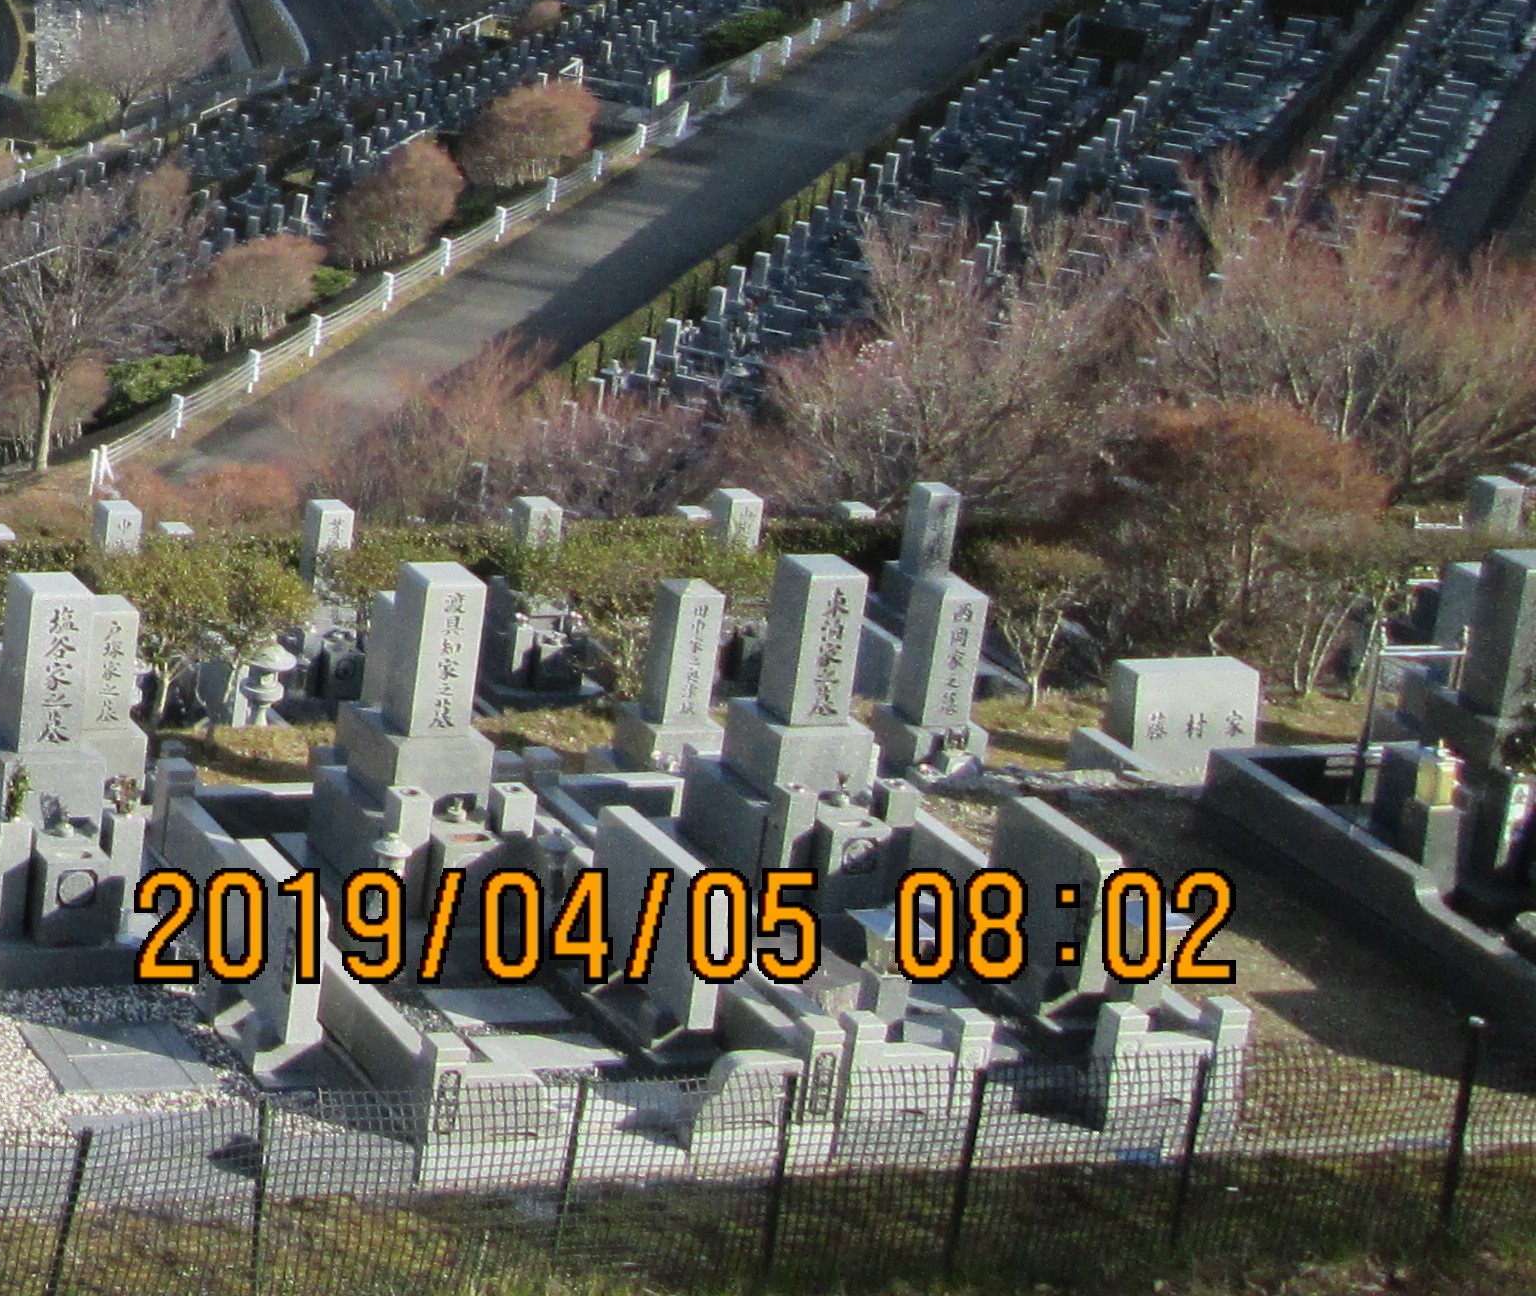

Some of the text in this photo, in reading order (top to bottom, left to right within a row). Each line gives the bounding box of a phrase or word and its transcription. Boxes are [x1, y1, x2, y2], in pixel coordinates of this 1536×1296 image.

[36, 606, 81, 744] 塩谷家之墓
[1147, 709, 1245, 740] 藤村家
